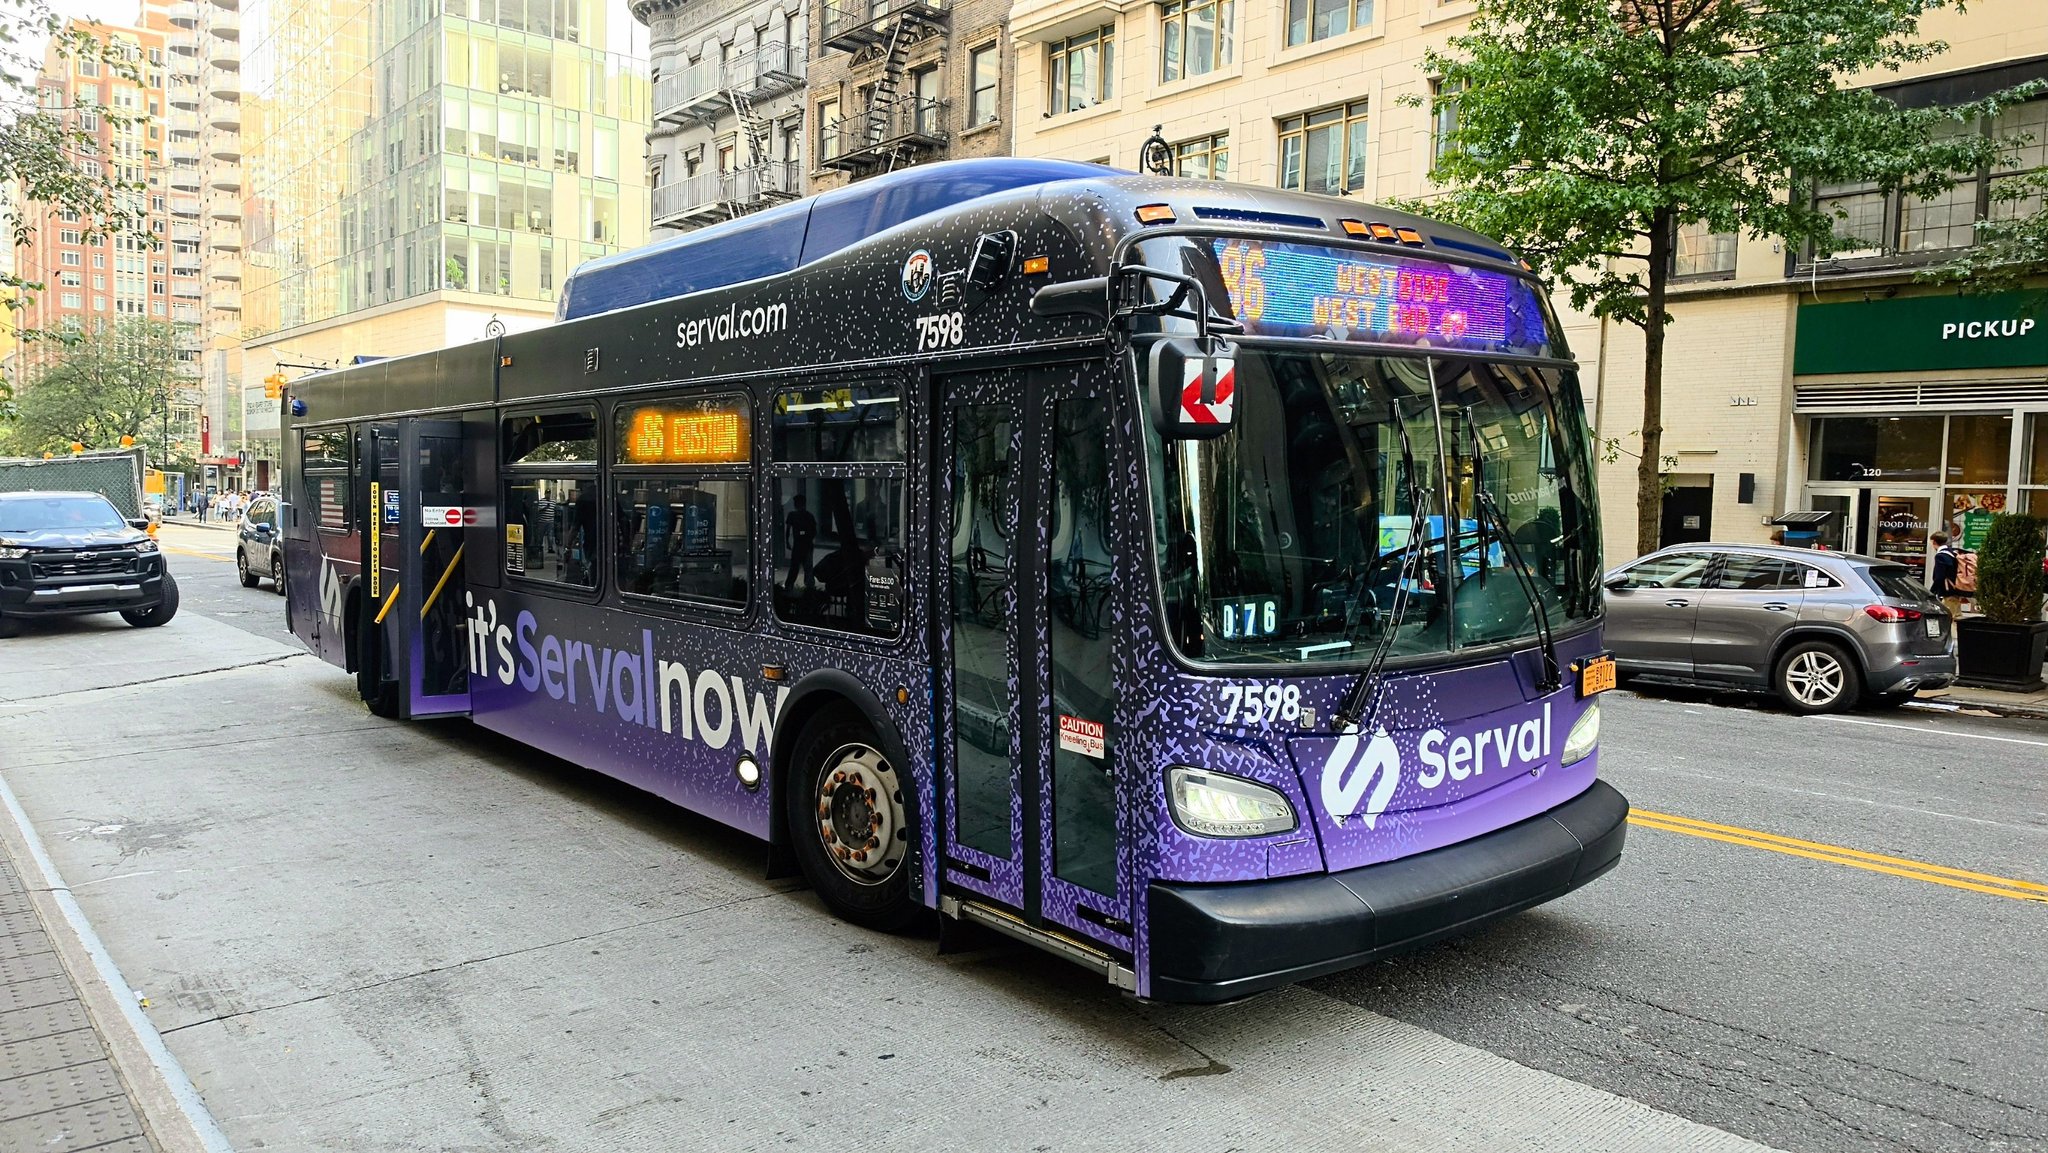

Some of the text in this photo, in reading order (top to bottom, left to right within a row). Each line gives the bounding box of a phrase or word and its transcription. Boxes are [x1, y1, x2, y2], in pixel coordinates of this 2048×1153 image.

[1337, 264, 1449, 302] WEST SIDE
[676, 302, 787, 348] serval.com
[916, 312, 963, 351] 7598
[1314, 297, 1376, 328] WEST
[1388, 304, 1430, 334] END
[1942, 319, 2035, 339] PICKUP
[1863, 468, 1882, 477] 120
[1879, 520, 1929, 529] FOOD HALL
[465, 591, 790, 758] it's Serval now
[1222, 684, 1300, 724] 7598
[1060, 716, 1103, 738] CAUTION
[1089, 739, 1104, 751] Bus
[1418, 702, 1551, 789] Serval
